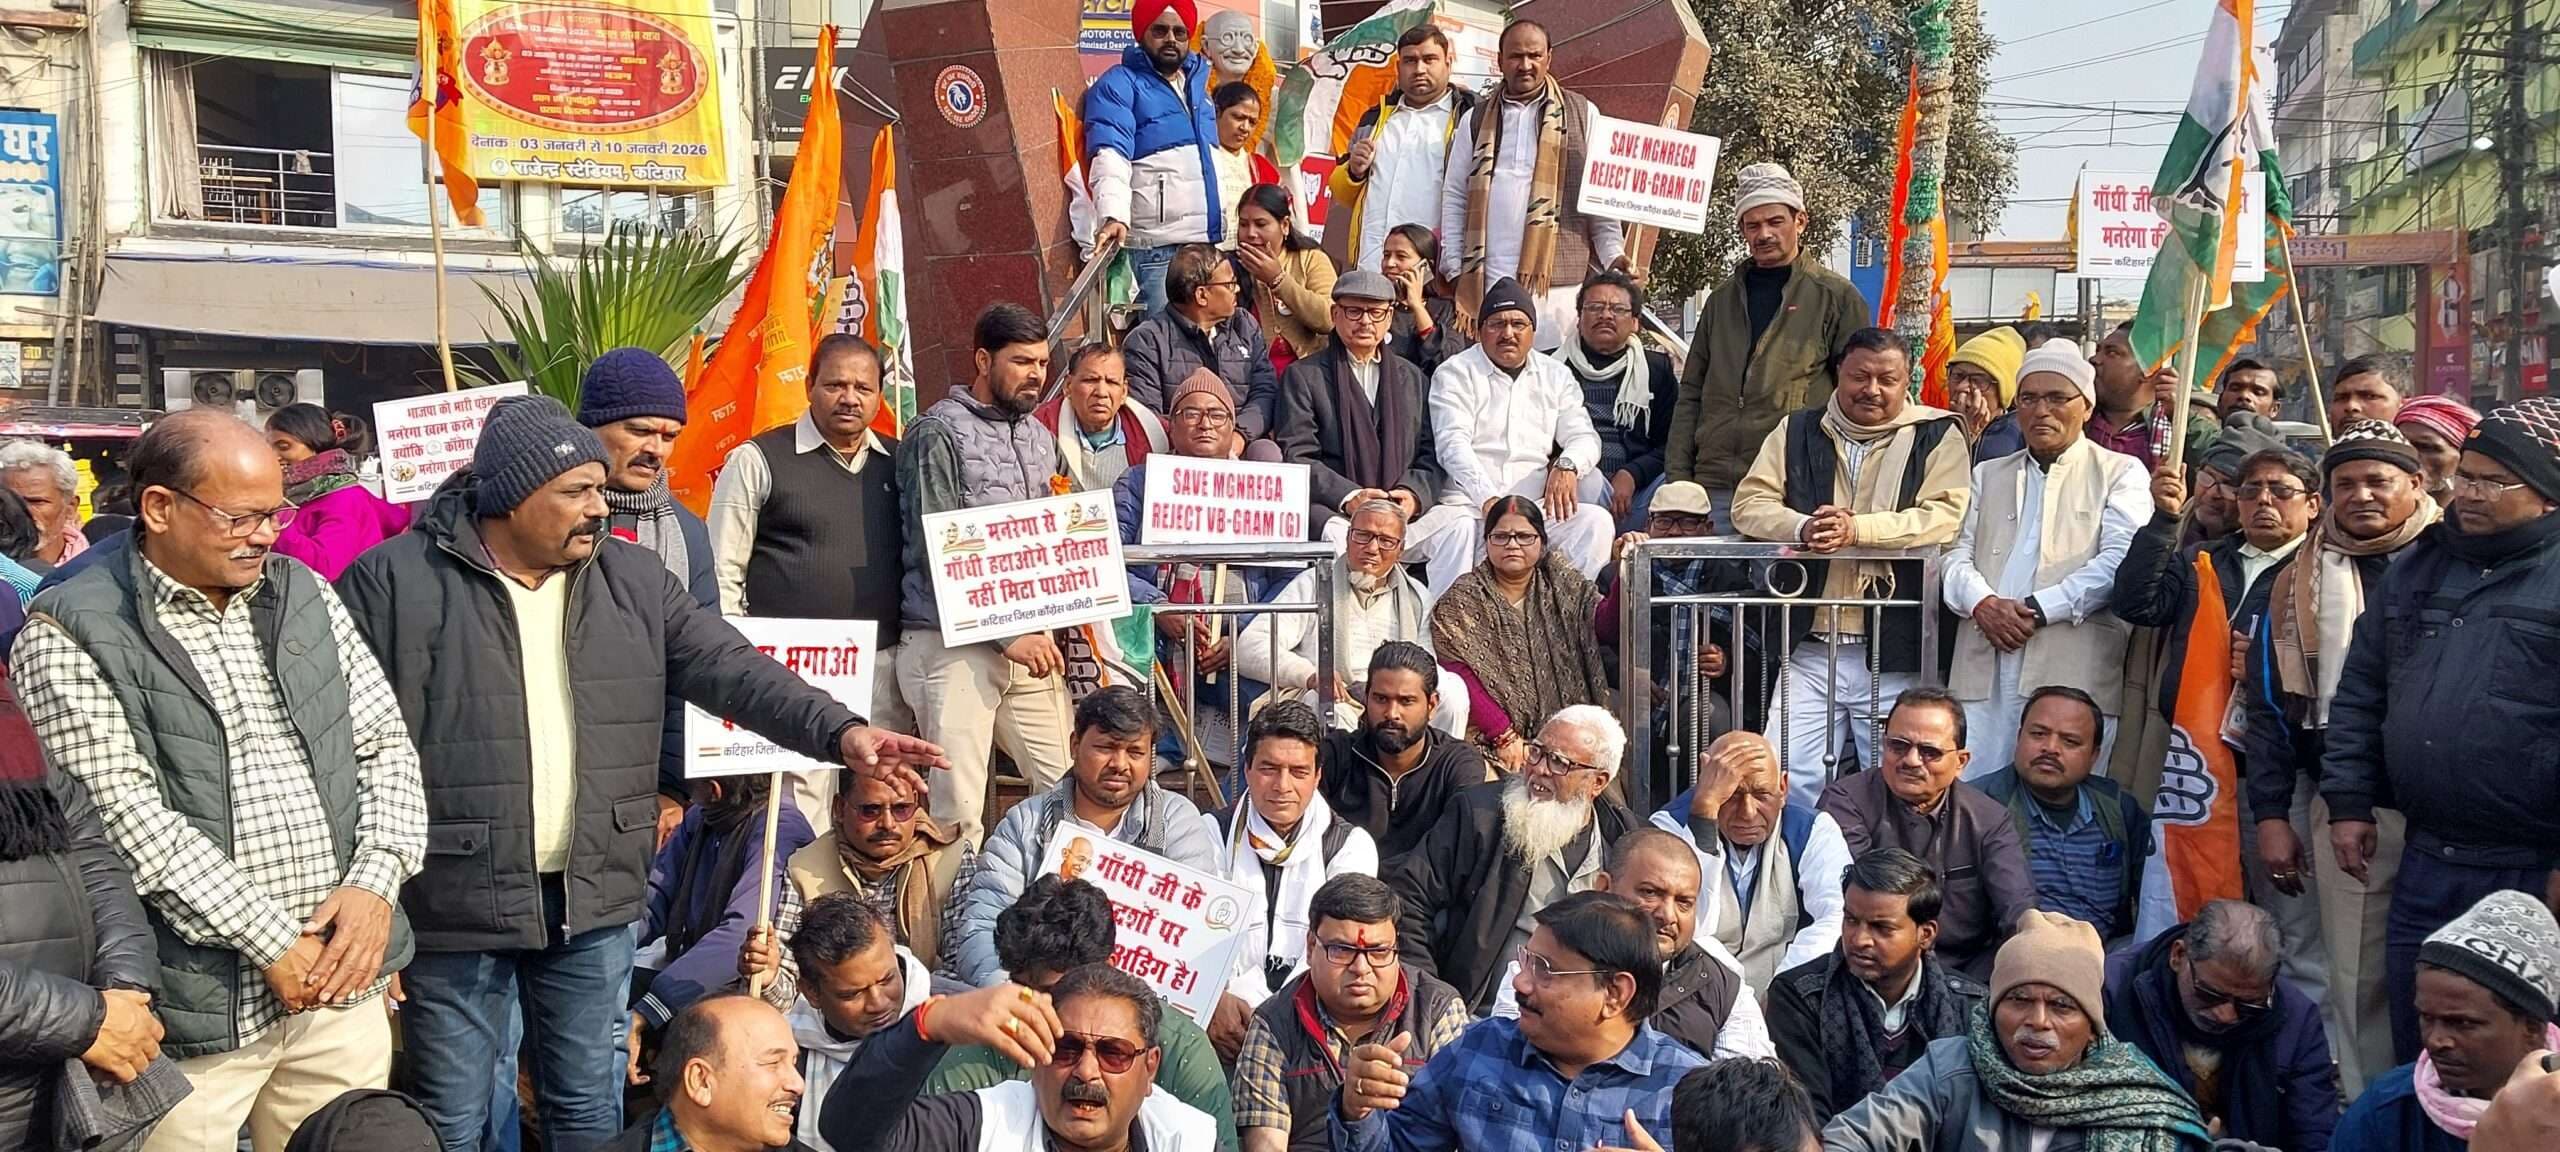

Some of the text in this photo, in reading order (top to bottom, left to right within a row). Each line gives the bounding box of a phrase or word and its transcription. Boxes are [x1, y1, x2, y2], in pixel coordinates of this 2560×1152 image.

[1080, 30, 1112, 38] MOTOR
[520, 138, 539, 150] 03
[543, 138, 586, 152] जनवरी
[591, 140, 600, 152] से
[605, 142, 622, 153] 10
[626, 141, 668, 154] जनवरी
[671, 144, 708, 155] 2026
[1610, 131, 1697, 170] SAVE MGNREGA
[511, 155, 561, 178] राजेन्द्र
[630, 160, 686, 181] कटिहार
[1589, 160, 1706, 204] REJECT VB-GRAM (G)
[2101, 220, 2148, 248] मनरेगा
[2114, 256, 2146, 268] कटिहार
[438, 400, 451, 414] को
[385, 425, 421, 442] मनरेगा
[424, 422, 448, 436] खत्म
[450, 418, 474, 432] करने
[417, 460, 447, 475] मनरेगा
[1172, 467, 1283, 502] SAVE MGNREGA
[985, 508, 1057, 541] मनरेगा से
[1152, 502, 1301, 538] REJECT VB-GRAM (G)
[986, 542, 1049, 575] हटाओगे
[1052, 536, 1109, 566] इतिहास
[966, 579, 997, 608] नहीं
[1000, 578, 1036, 603] मिटा
[980, 613, 1013, 626] कटिहार
[1013, 609, 1036, 621] जिला
[1066, 596, 1093, 611] कमिटी
[723, 742, 754, 757] कटिहार
[755, 741, 777, 755] जिला
[1148, 872, 1181, 902] जी
[1182, 881, 1207, 910] के
[1109, 901, 1189, 947] दर्शों पर
